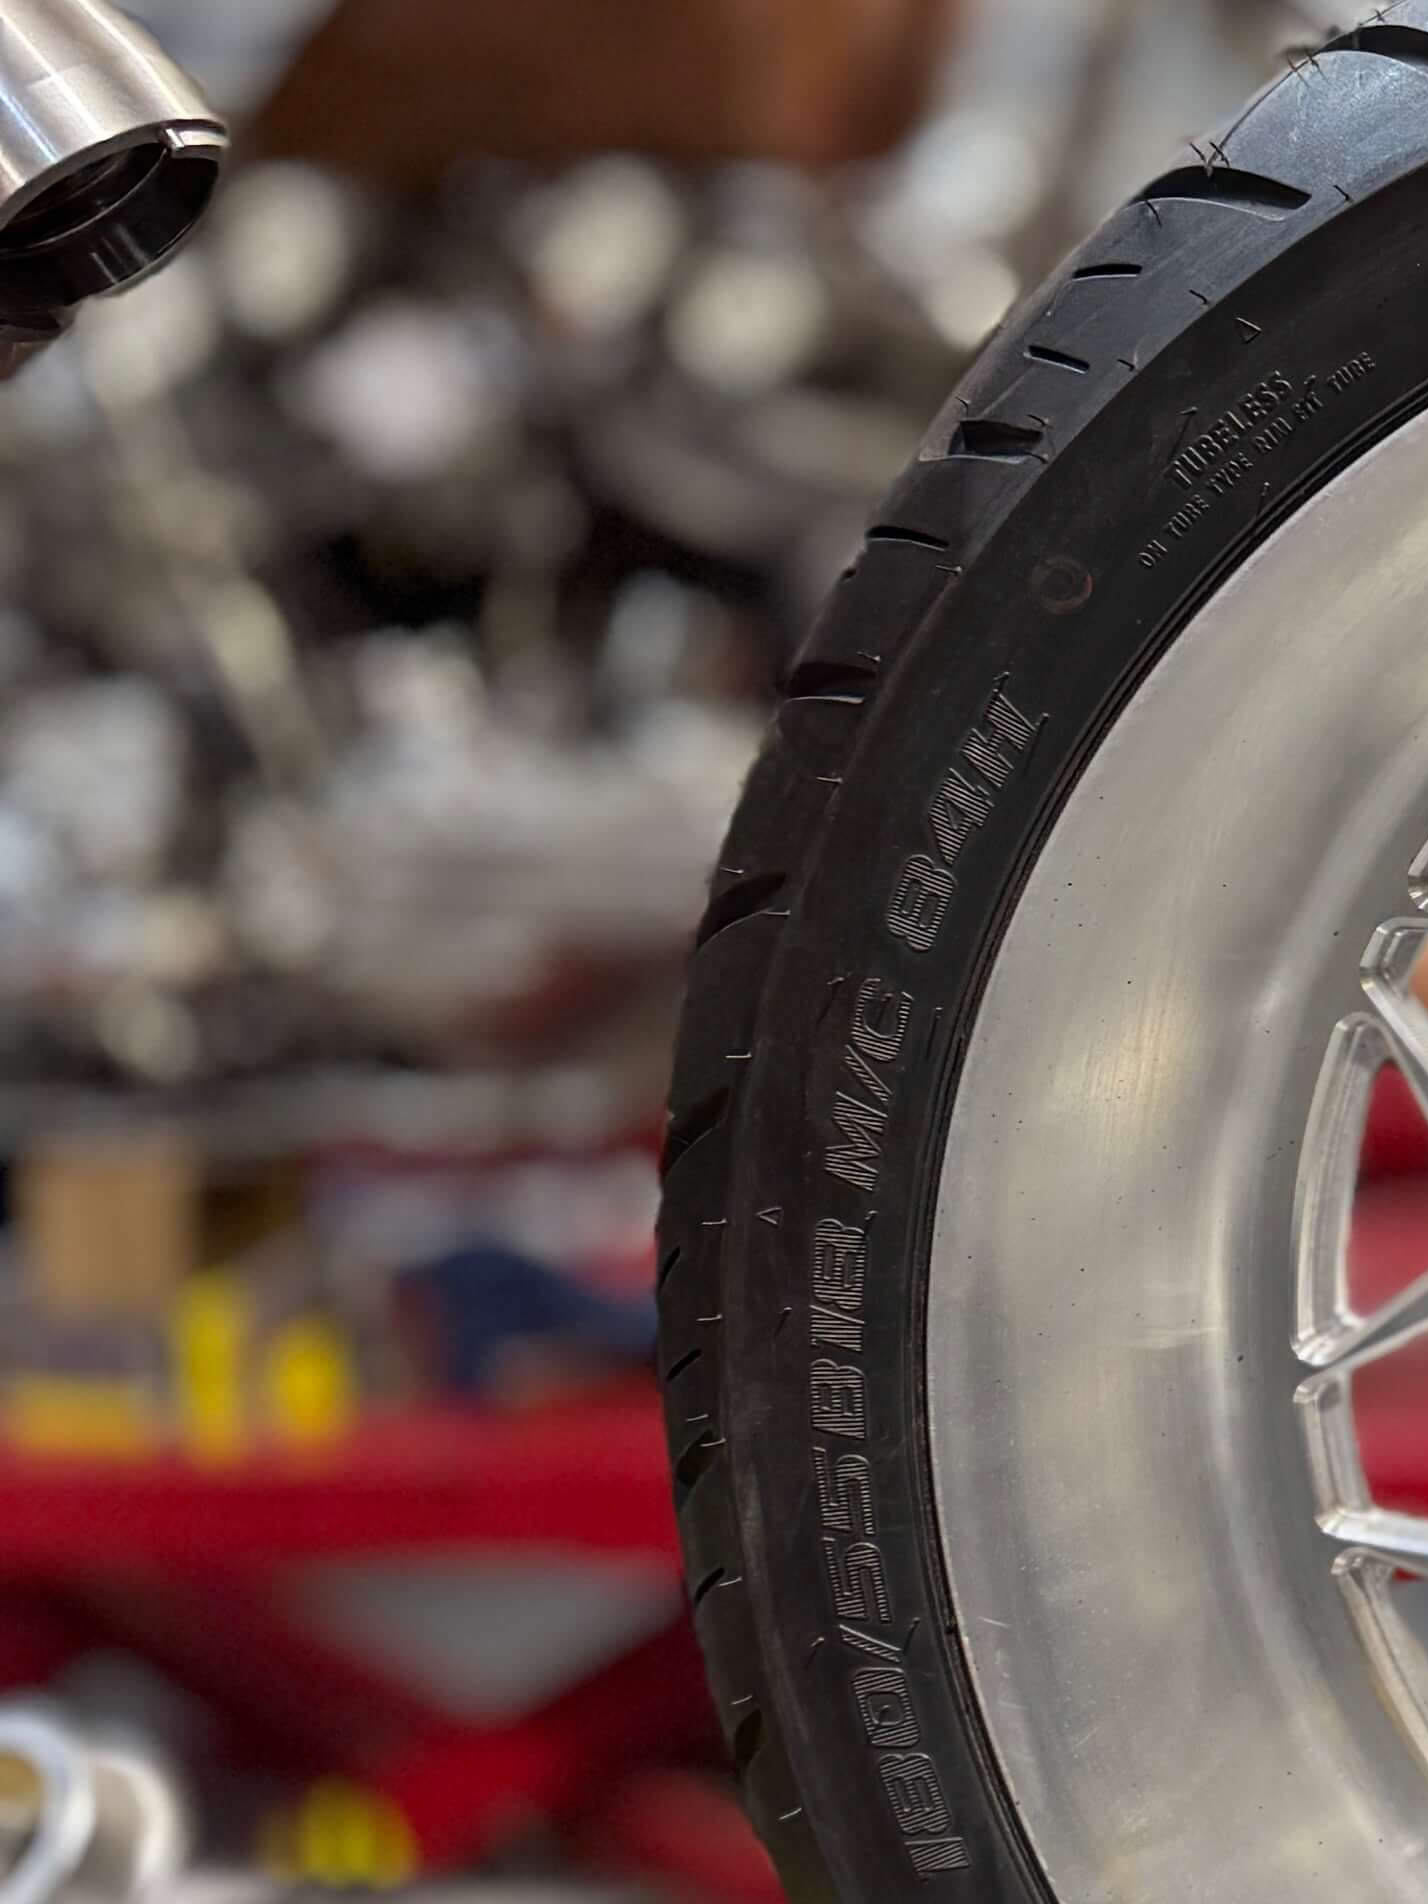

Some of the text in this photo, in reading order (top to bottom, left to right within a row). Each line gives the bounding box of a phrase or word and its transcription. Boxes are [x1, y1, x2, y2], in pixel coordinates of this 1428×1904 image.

[1160, 364, 1297, 495] TUBELESS
[1202, 446, 1259, 500] TYPE
[817, 969, 922, 1194] M/C
[873, 682, 1047, 957] 84H
